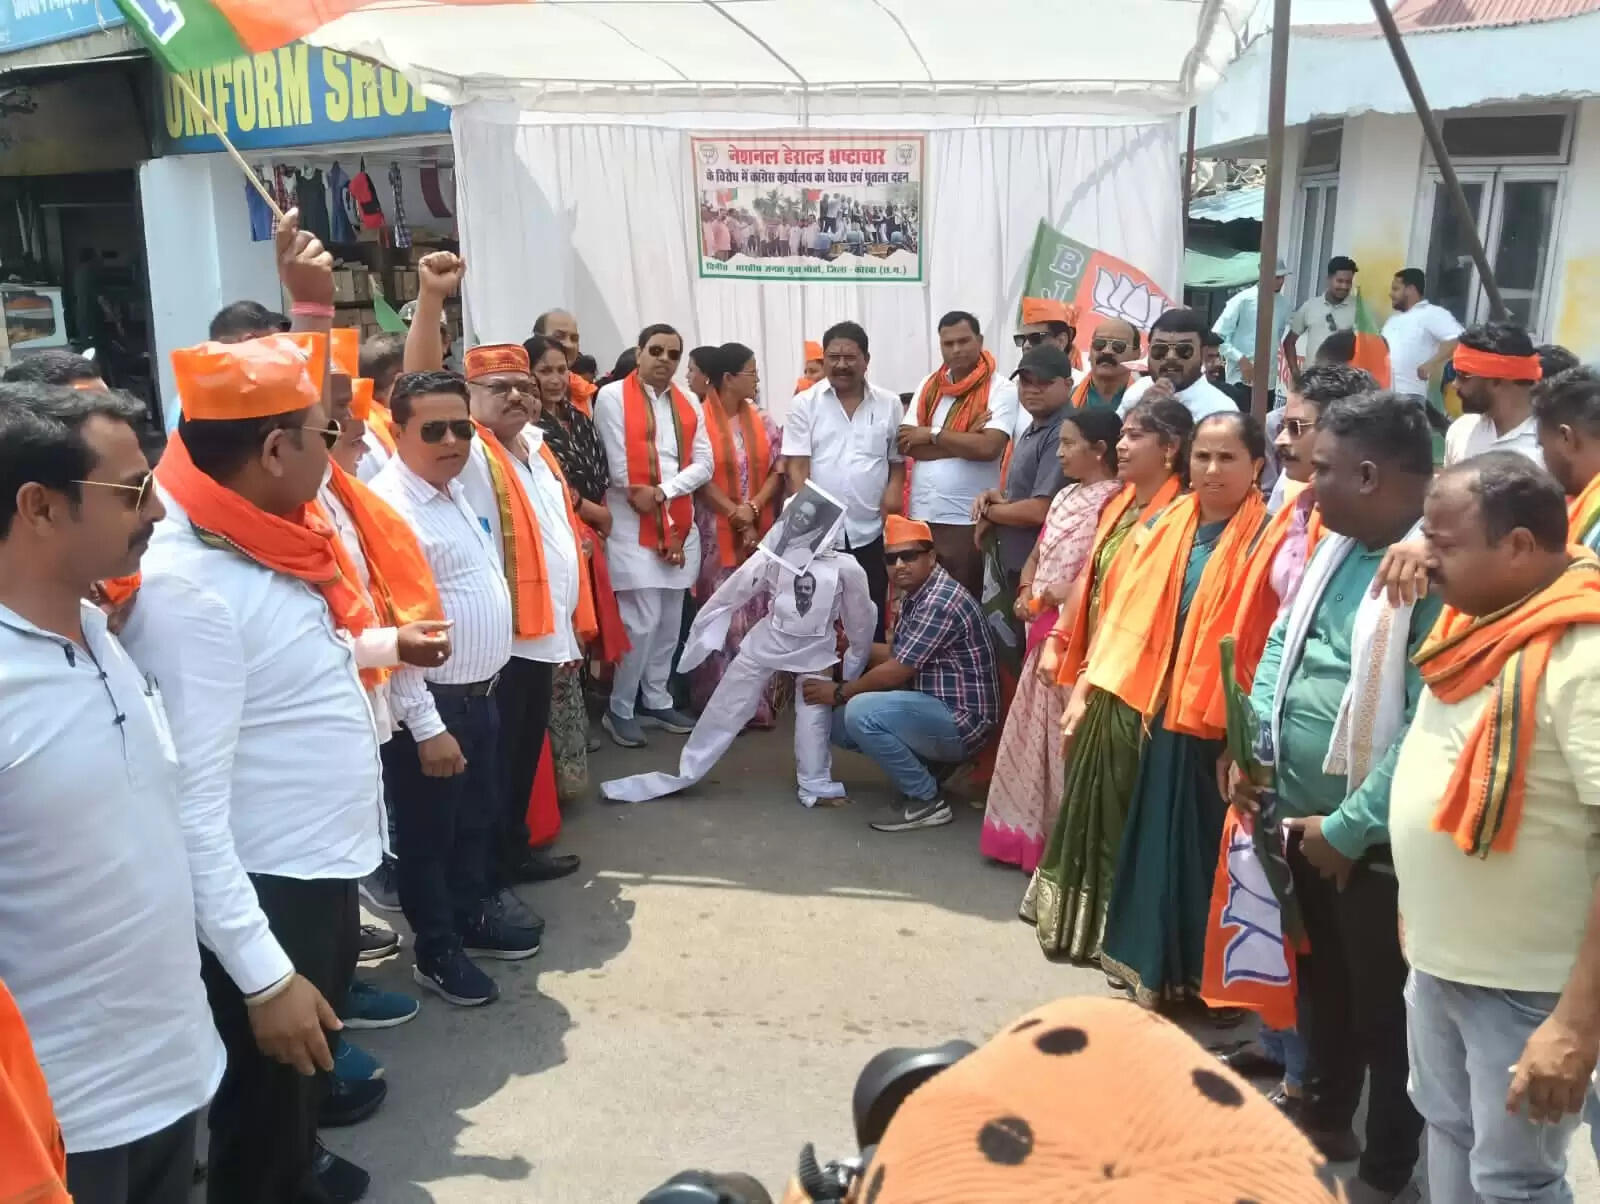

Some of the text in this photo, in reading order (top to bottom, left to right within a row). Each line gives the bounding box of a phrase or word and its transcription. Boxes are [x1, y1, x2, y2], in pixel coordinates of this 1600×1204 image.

[164, 44, 313, 138] UNIFORM
[728, 143, 887, 165] नेशनल हेराल्ड भ्रष्टाचार
[705, 168, 714, 181] के
[716, 168, 739, 183] विरोध
[741, 168, 749, 182] में
[777, 168, 813, 184] कार्यालय
[814, 171, 825, 183] का
[827, 168, 848, 183] घेराव
[850, 168, 863, 183] एवं
[891, 171, 909, 183] दहन
